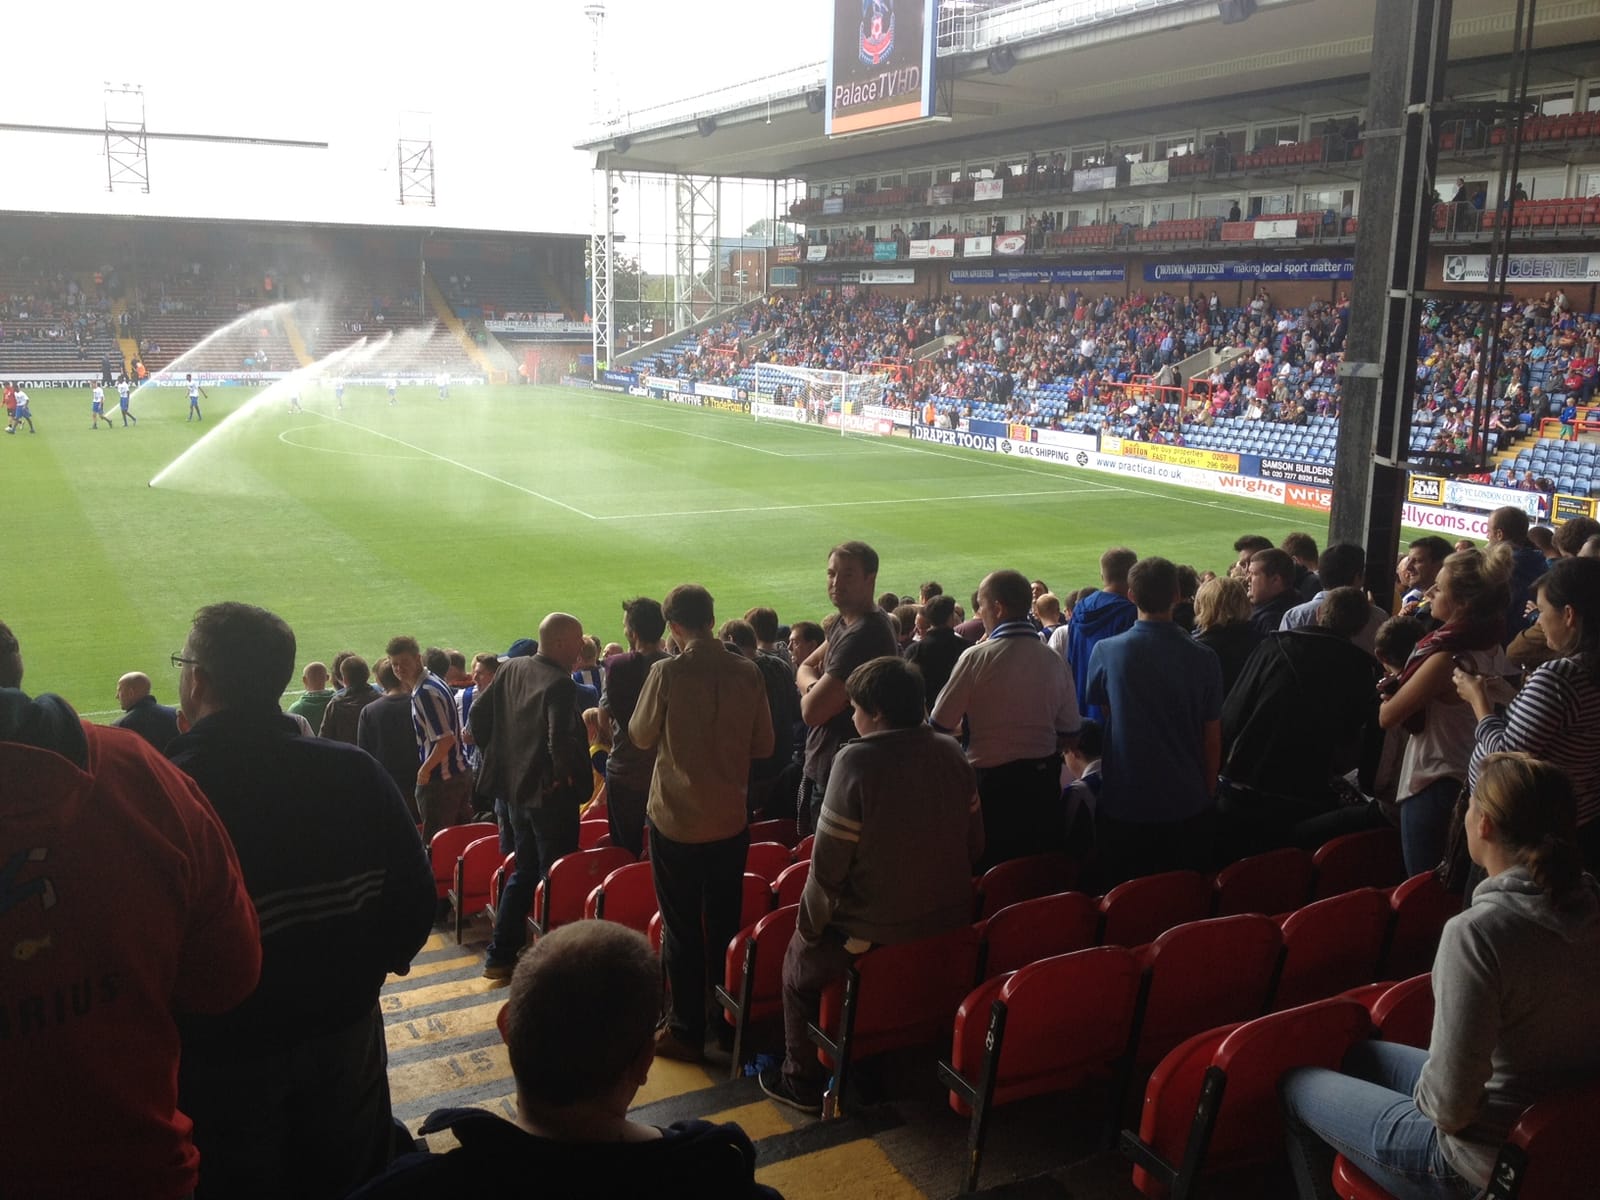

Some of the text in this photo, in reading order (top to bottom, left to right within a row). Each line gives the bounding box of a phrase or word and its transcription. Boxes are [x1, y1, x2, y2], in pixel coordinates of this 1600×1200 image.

[834, 82, 877, 108] Palace
[1233, 263, 1260, 276] making
[1262, 262, 1283, 273] local
[1284, 262, 1308, 275] sport
[1310, 261, 1342, 273] matter
[915, 425, 957, 446] DRAPER
[957, 433, 995, 451] TOOLS
[1019, 445, 1070, 462] GAC SHIPPING
[1125, 446, 1148, 457] SUTTON
[1152, 453, 1167, 461] FAST
[1173, 447, 1204, 458] properties
[1262, 459, 1334, 477] SAMSON BUILDERS
[1218, 475, 1284, 497] Wrights
[1288, 486, 1332, 506] Wrig
[1401, 504, 1489, 534] ellycoms.co
[382, 994, 404, 1012] 3
[404, 1016, 448, 1040] 14
[446, 1050, 495, 1078] 15
